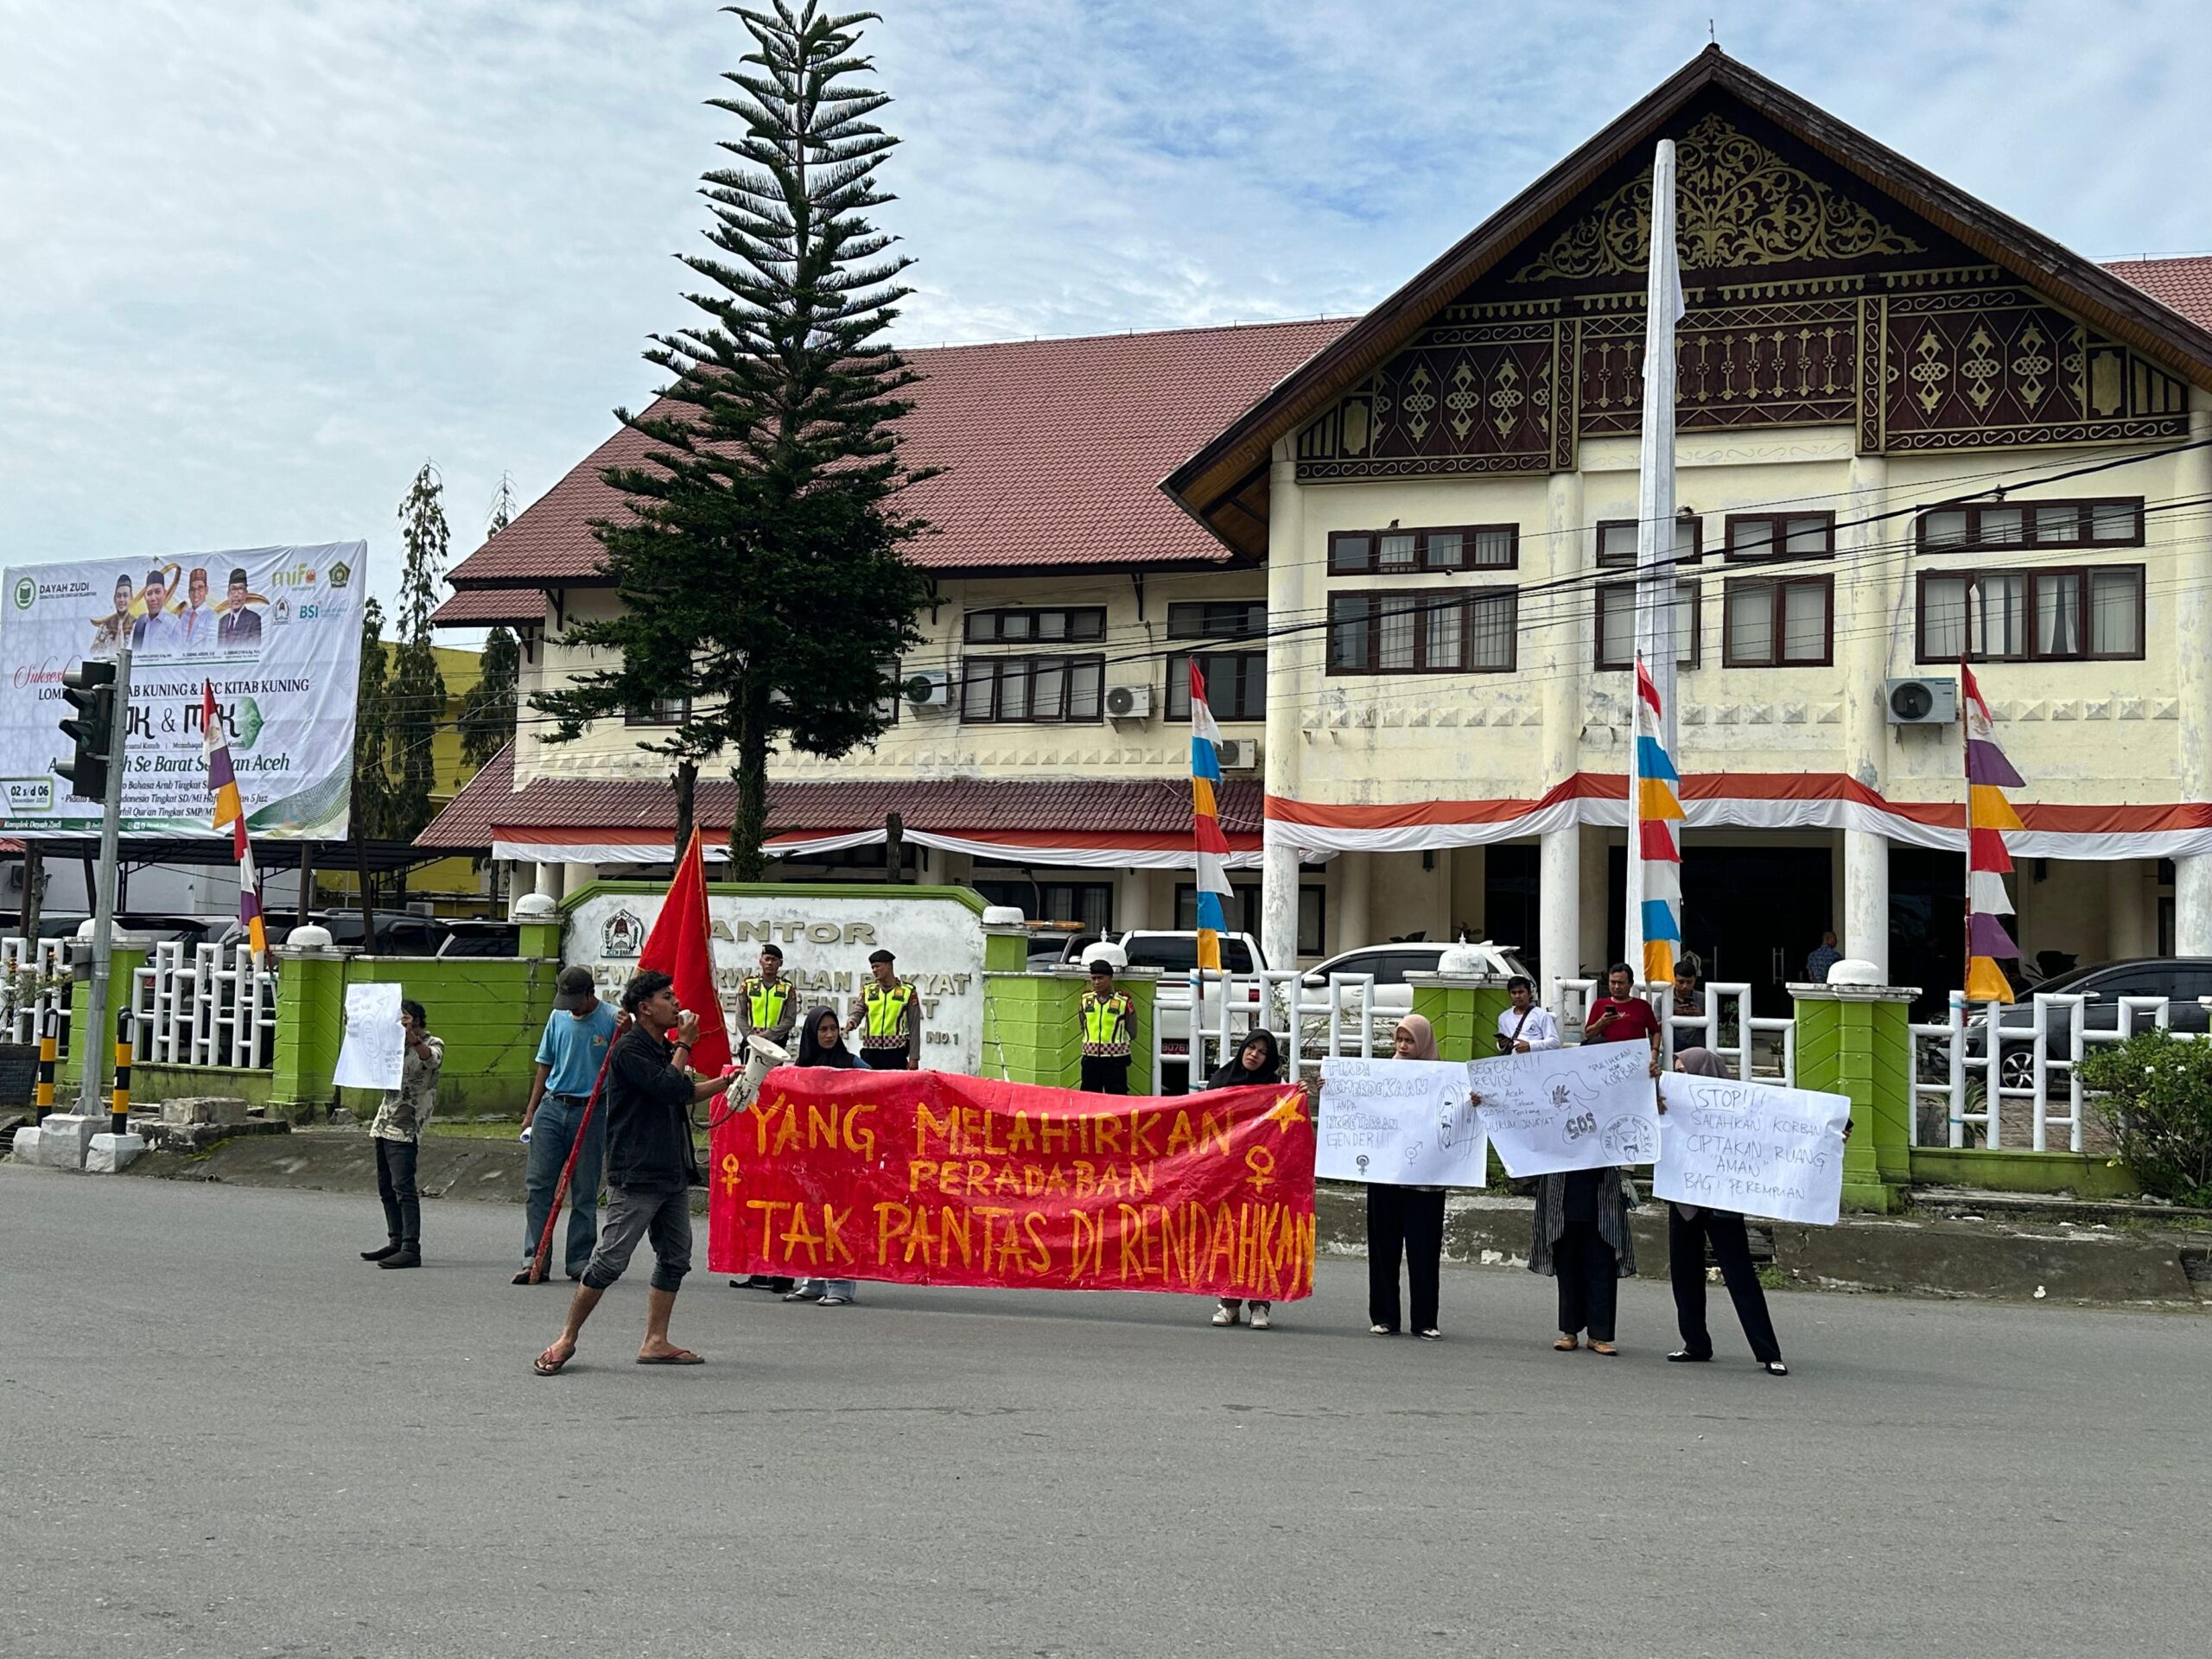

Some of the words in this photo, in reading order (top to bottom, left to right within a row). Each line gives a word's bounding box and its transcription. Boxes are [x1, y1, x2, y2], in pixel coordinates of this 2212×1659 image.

[40, 584, 67, 594] DAYAH
[69, 582, 89, 592] ZUDI
[300, 605, 318, 619] BSI
[143, 683, 188, 696] KUNING
[190, 683, 198, 696] &
[225, 680, 258, 694] KITAB
[261, 678, 309, 694] KUNING
[162, 708, 175, 733] &
[135, 756, 151, 772] Se
[155, 755, 190, 772] Barat
[253, 753, 289, 771] Aceh
[10, 785, 21, 796] 02
[38, 785, 49, 796] 06
[128, 780, 154, 790] Bahasa
[156, 780, 173, 790] Arab
[174, 779, 200, 791] Tingkat
[119, 793, 149, 803] ndonesia
[151, 793, 177, 804] Tingkat
[158, 807, 185, 818] Tingkat
[187, 807, 216, 817] SMP/MT
[710, 919, 877, 945] ANTOR
[1325, 1059, 1370, 1077] TIADA
[1475, 1073, 1511, 1088] REVISI
[1325, 1098, 1357, 1113] TANPA
[749, 1092, 877, 1162] YANG
[917, 1102, 1234, 1156] MELAHIRKAN
[1690, 1110, 1761, 1132] SALAHKAN
[1773, 1118, 1821, 1136] KORBAN
[1687, 1135, 1763, 1159] CIPTAKAN
[1774, 1146, 1827, 1173] RUANG
[908, 1159, 1155, 1199] PERADABAN
[1684, 1173, 1720, 1194] BAGI
[1730, 1179, 1805, 1200] PEREMPUAN
[746, 1199, 855, 1267] TAK
[874, 1202, 1052, 1279] PANTAS
[1068, 1208, 1105, 1285] DI
[1118, 1200, 1315, 1296] RENDAHKAN
